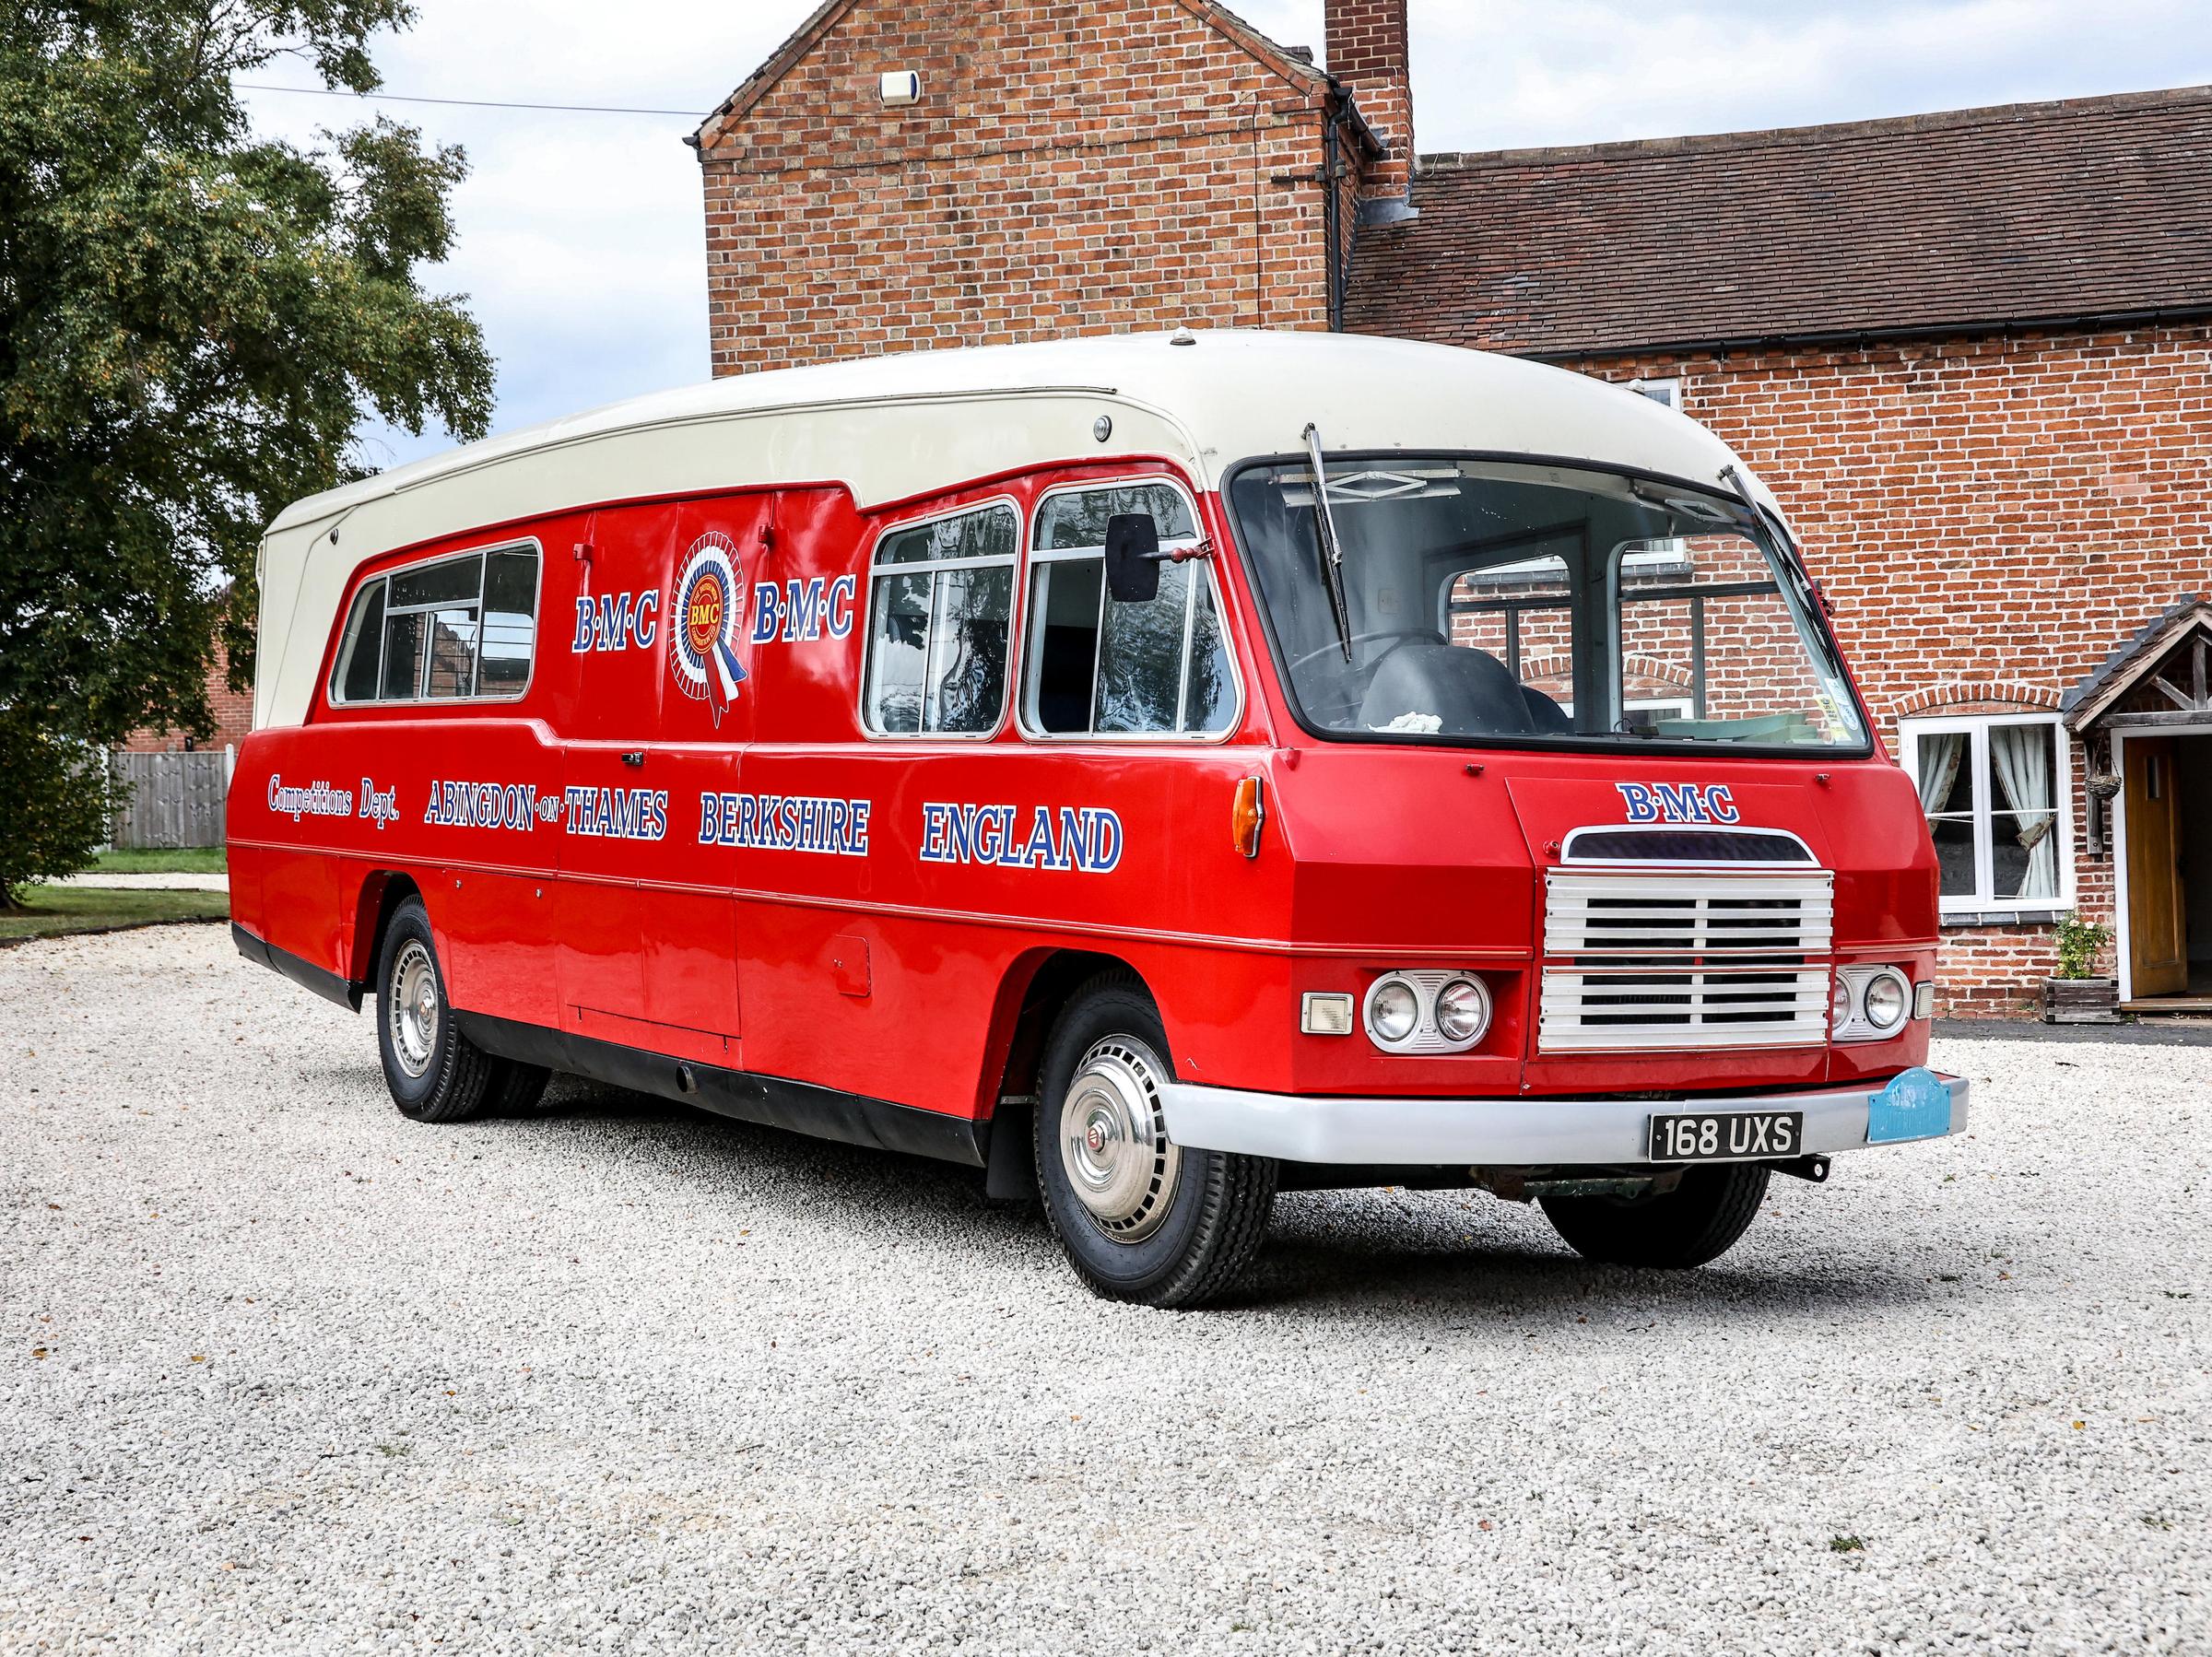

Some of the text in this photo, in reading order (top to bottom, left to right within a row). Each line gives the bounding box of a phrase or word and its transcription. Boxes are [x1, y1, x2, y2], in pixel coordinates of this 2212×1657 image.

[689, 603, 720, 626] BMC
[267, 773, 400, 829] Competitions Dept.
[698, 791, 871, 857] BERKSHIRE
[920, 802, 1124, 874] ENGLAND
[1665, 1116, 1794, 1157] 168 UXS
